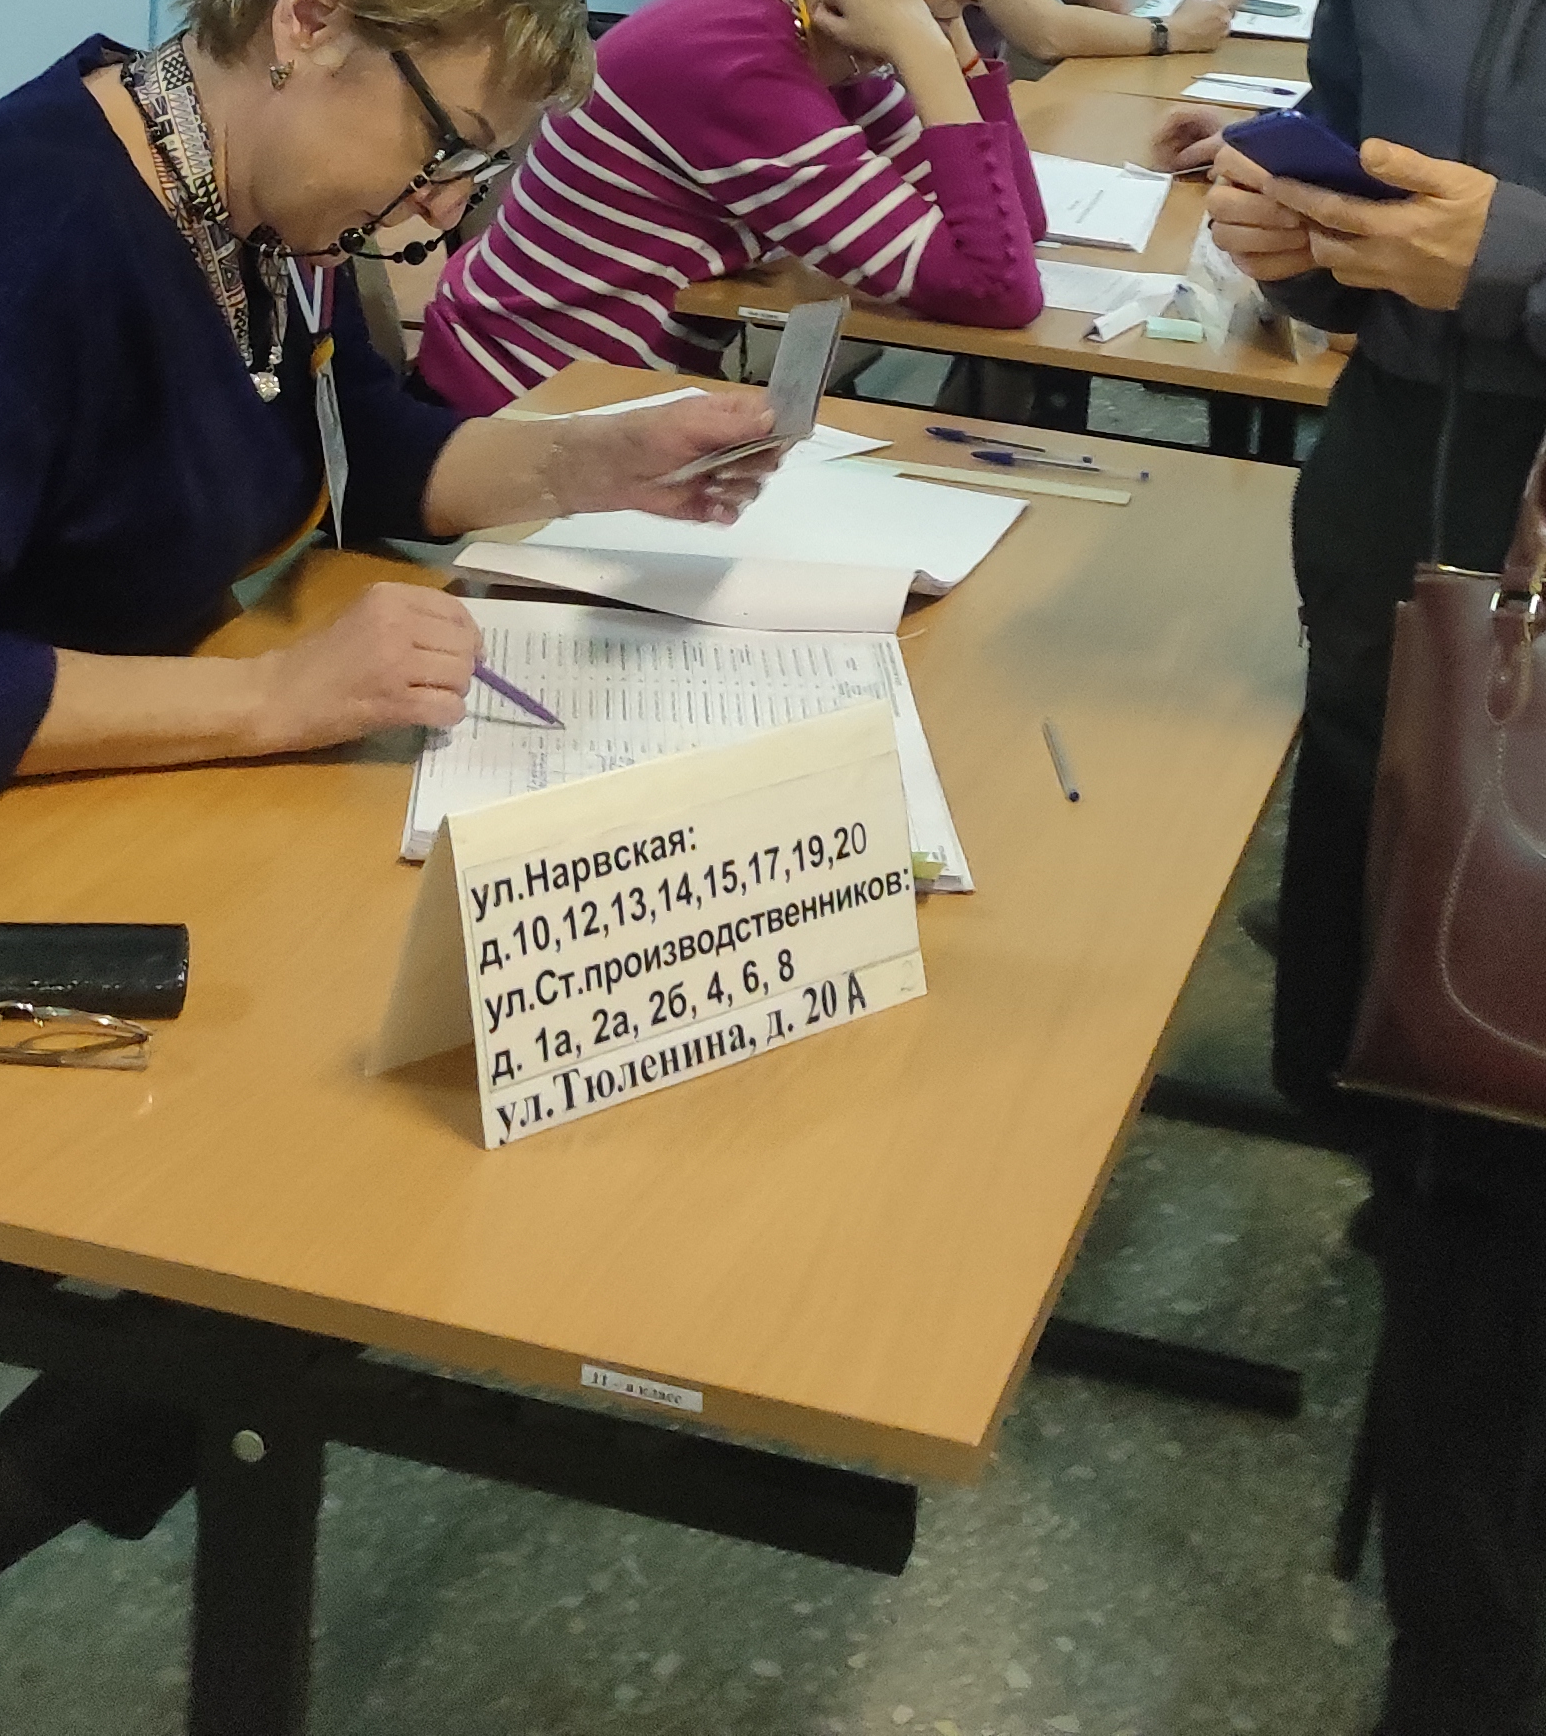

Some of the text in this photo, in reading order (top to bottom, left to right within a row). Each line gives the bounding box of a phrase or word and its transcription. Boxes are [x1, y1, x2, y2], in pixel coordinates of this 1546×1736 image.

[470, 825, 698, 923] ул.Нарвская:
[480, 821, 868, 975] д.10,12,13,14,15,17,19,20
[484, 866, 911, 1033] ул.Ст.производственников:
[491, 949, 795, 1085] д. 1а, 2а, 2б, 4, 6, 8
[495, 1020, 758, 1147] ул.Тюленина,
[766, 1009, 795, 1045] д.
[803, 979, 837, 1027] 20
